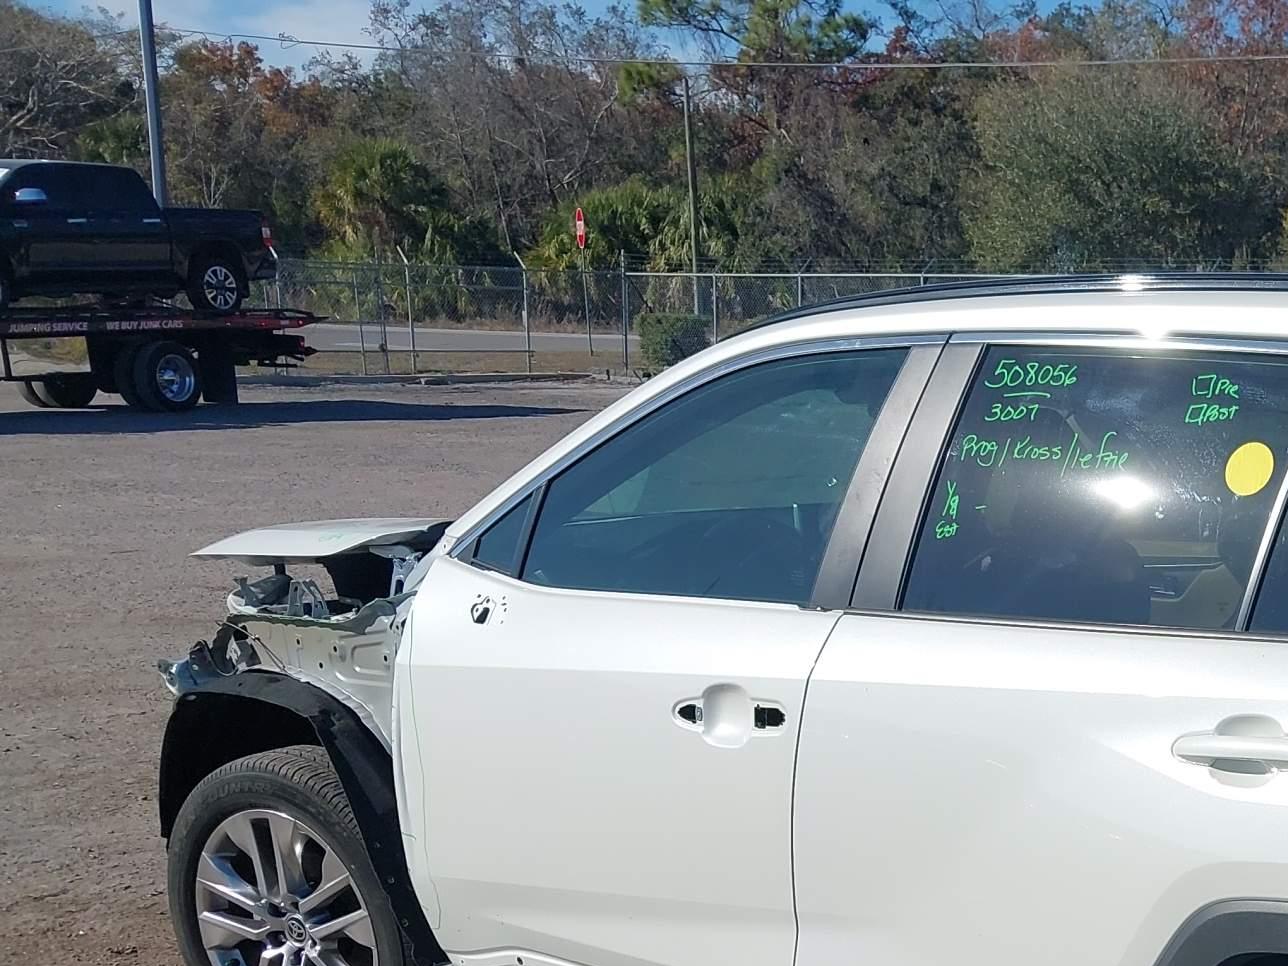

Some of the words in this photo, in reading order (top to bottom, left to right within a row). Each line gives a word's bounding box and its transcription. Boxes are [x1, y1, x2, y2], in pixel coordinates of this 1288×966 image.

[52, 322, 88, 331] SERVICE
[106, 321, 120, 330] WE
[121, 321, 139, 330] BUY
[138, 320, 161, 330] JUNK
[162, 320, 184, 329] CARS
[984, 359, 1077, 388] 508056
